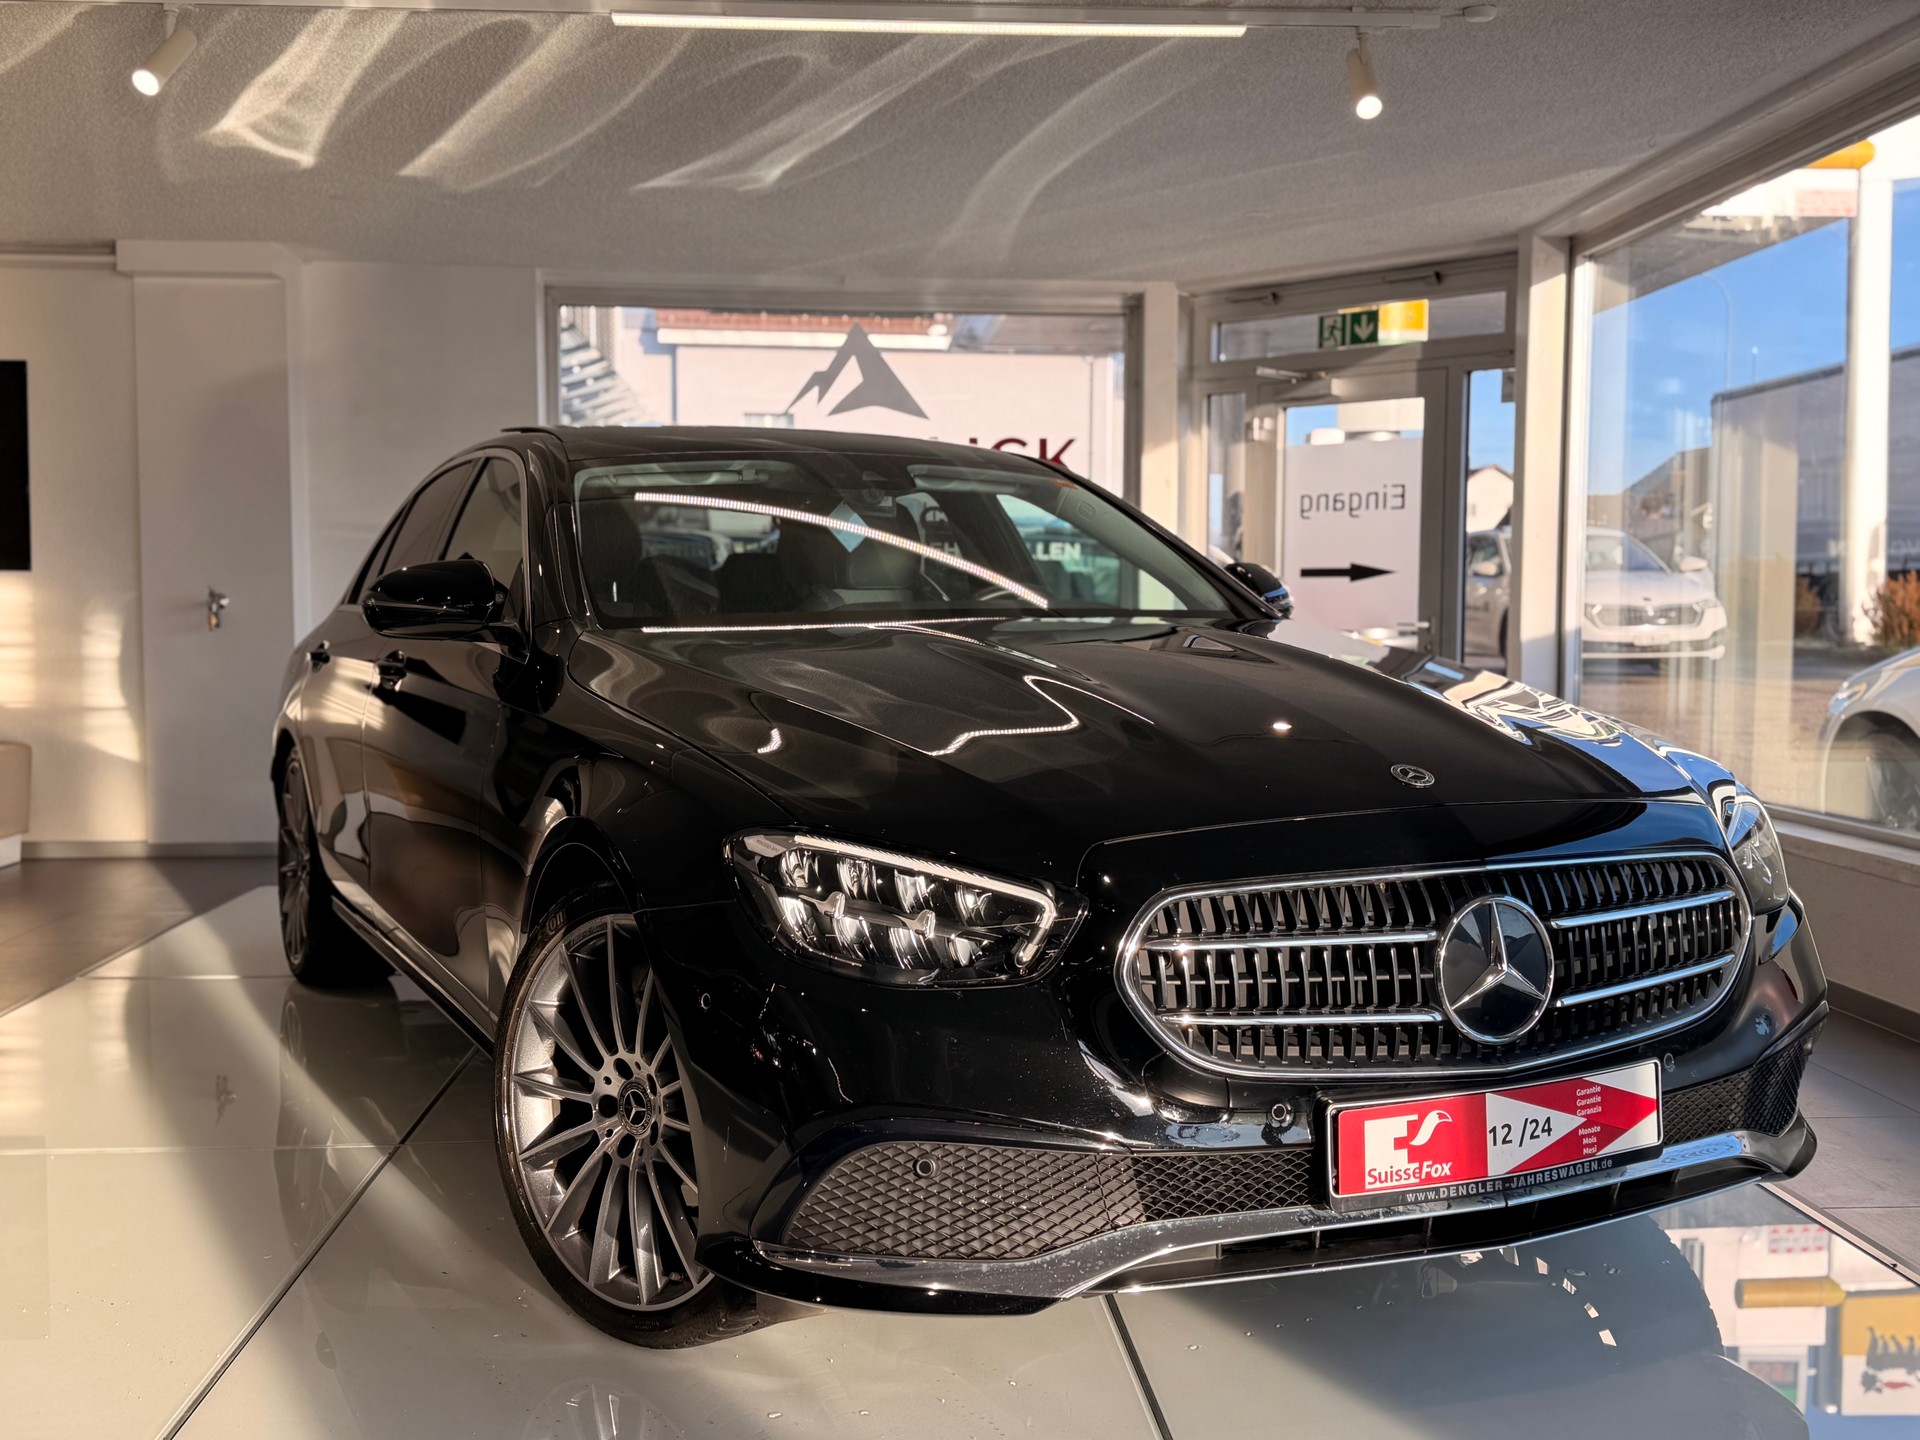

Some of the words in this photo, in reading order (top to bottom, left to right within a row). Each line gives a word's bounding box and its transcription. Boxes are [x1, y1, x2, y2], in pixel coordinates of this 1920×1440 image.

[1576, 1085, 1601, 1096] Garantie
[1576, 1095, 1601, 1107] Garantie
[1576, 1105, 1602, 1117] Garanzia
[1578, 1125, 1601, 1136] Monate
[1582, 1136, 1597, 1146] Mois
[1583, 1145, 1598, 1156] Mesi
